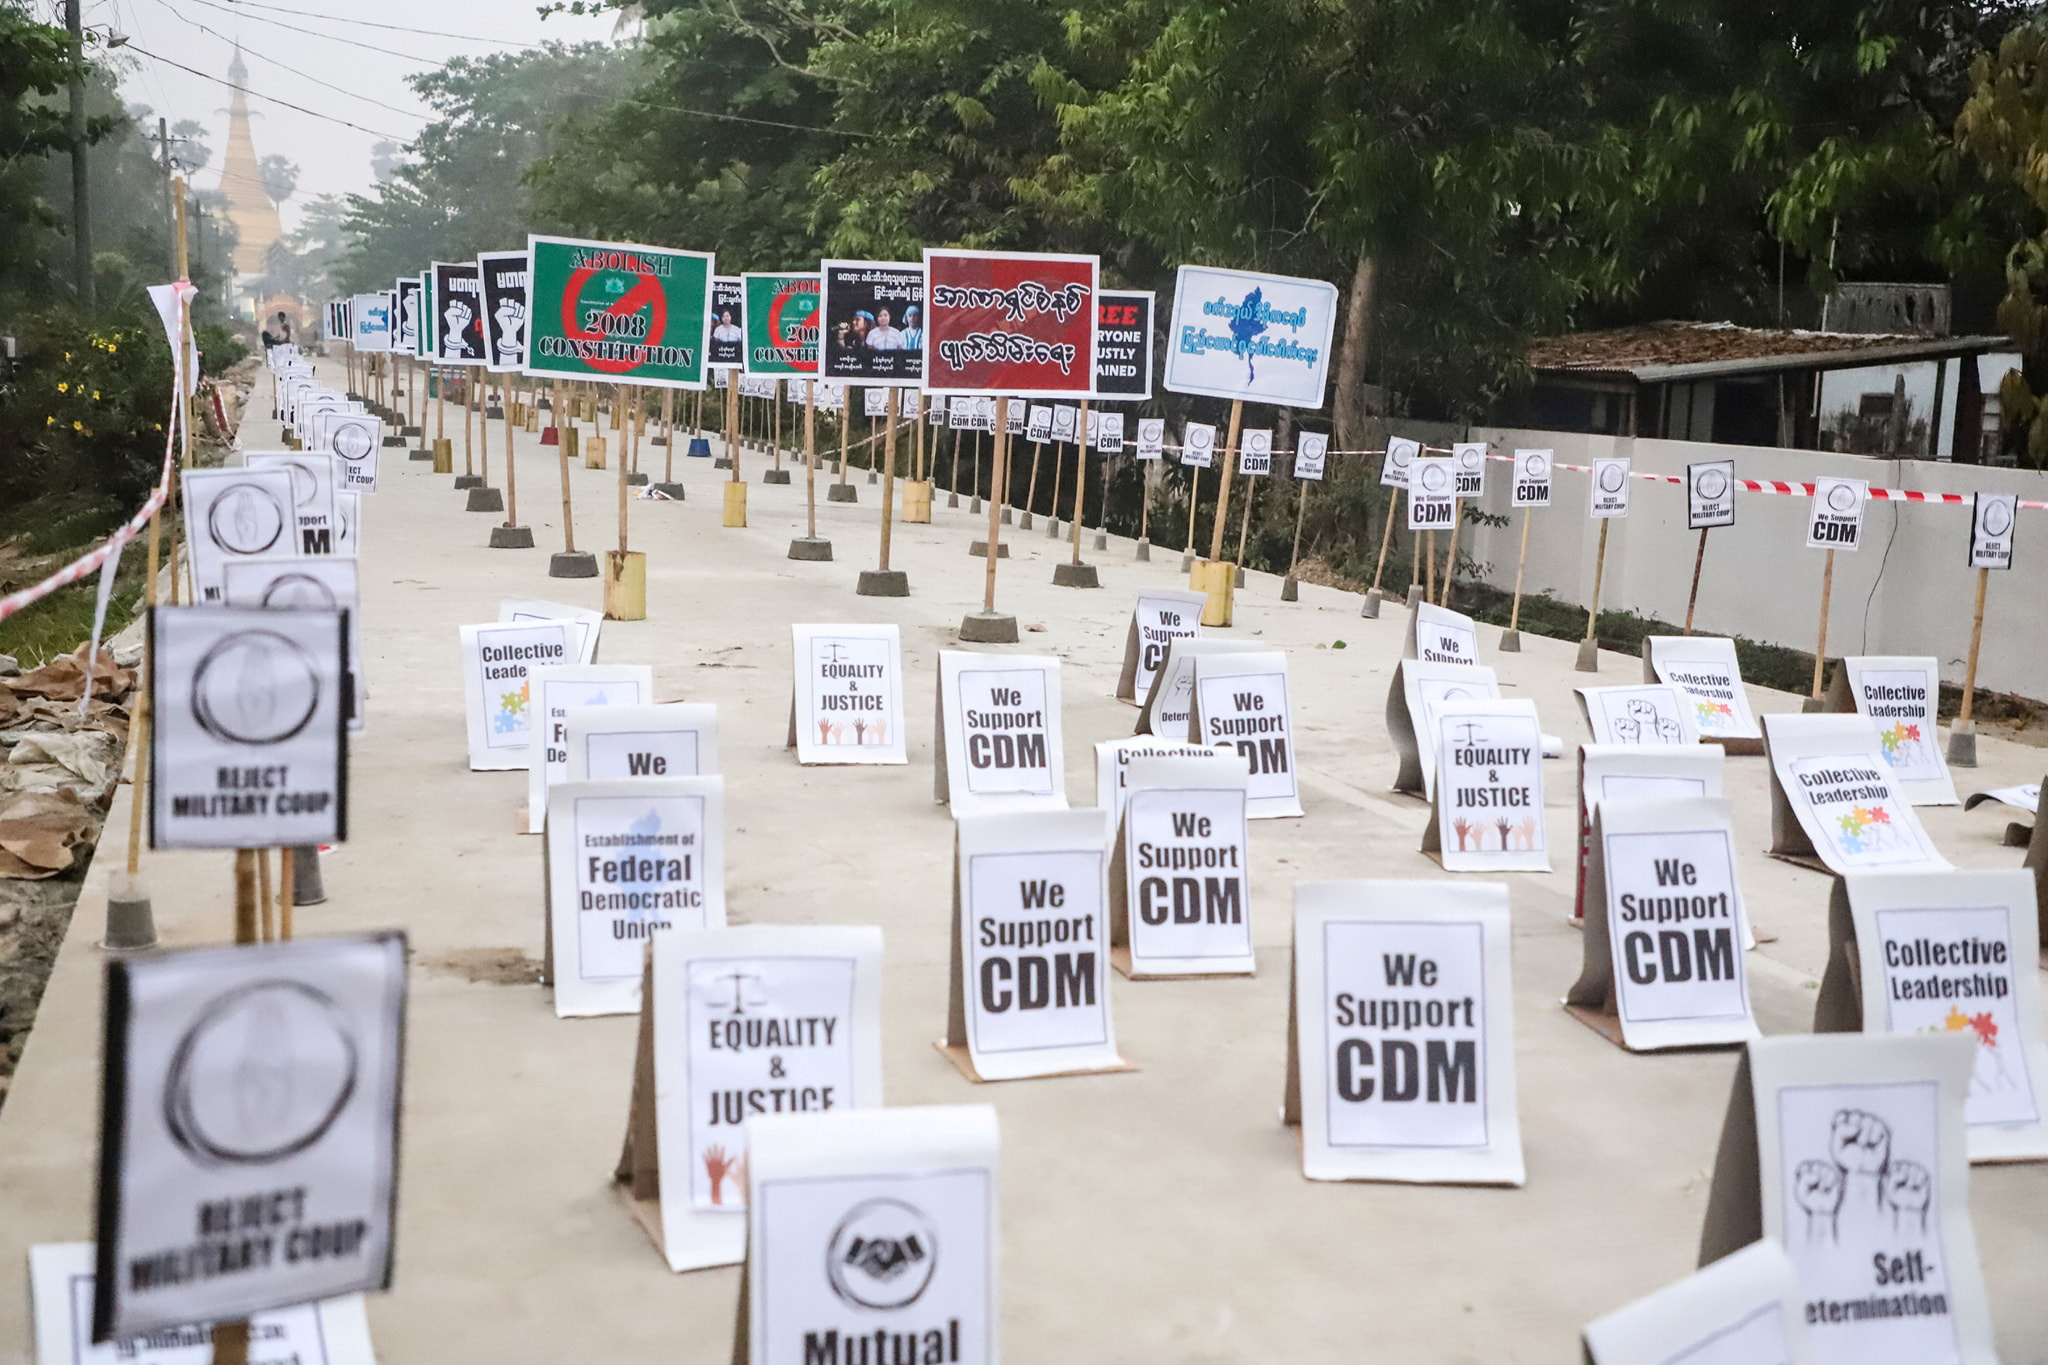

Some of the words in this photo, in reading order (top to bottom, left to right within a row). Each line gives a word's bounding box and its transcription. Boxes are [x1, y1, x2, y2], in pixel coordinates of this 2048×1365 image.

[570, 248, 672, 277] ABOLISH
[772, 279, 820, 295] ABOL
[933, 281, 1091, 323] အာဏာရှင်စနစ်
[585, 312, 646, 338] 2008
[1098, 305, 1139, 325] REE
[787, 325, 820, 343] 200
[1098, 330, 1142, 343] RYONE
[539, 336, 693, 367] CONSTITUTION
[754, 347, 820, 362] CONSTI
[1097, 347, 1136, 360] USTLY
[1097, 364, 1137, 377] AINED
[951, 417, 969, 426] CDM
[1030, 427, 1051, 439] CDM
[1100, 438, 1121, 448] CDM
[349, 466, 361, 474] ECT
[1244, 458, 1269, 471] CDM
[356, 475, 374, 485] COUP
[1455, 477, 1481, 492] CDM
[1426, 494, 1450, 503] Support
[1517, 485, 1549, 501] CDM
[299, 514, 327, 526] port
[1413, 504, 1452, 523] CDM
[1692, 510, 1716, 519] MILITARY
[1716, 509, 1730, 518] COUP
[1817, 513, 1829, 521] We
[1830, 513, 1857, 523] Support
[1813, 521, 1857, 543] CDM
[1160, 611, 1181, 627] We
[482, 642, 563, 663] Collective
[1440, 636, 1459, 653] We
[485, 663, 528, 680] Leade
[821, 663, 884, 679] EQUALITY
[1669, 671, 1731, 687] Collective
[849, 681, 858, 692] &
[991, 687, 1022, 707] We
[1685, 685, 1734, 701] adership
[1864, 684, 1926, 701] Collective
[821, 695, 884, 711] JUSTICE
[1233, 692, 1264, 712] We
[1868, 703, 1926, 719] Leadership
[967, 709, 1043, 730] Support
[1210, 714, 1284, 737] Support
[969, 733, 1047, 769] CDM
[1214, 738, 1288, 775] DM
[1455, 747, 1531, 768] EQUALITY
[628, 752, 667, 776] We
[216, 766, 288, 789] REJECT
[1488, 769, 1499, 783] &
[1798, 767, 1881, 788] Collective
[172, 794, 269, 818] MILITARY
[275, 792, 331, 815] COUP
[1456, 787, 1531, 808] JUSTICE
[1809, 785, 1889, 805] Leadership
[1172, 812, 1212, 838] We
[585, 833, 679, 848] Establishment
[682, 833, 695, 846] of
[1138, 842, 1239, 870] Support
[588, 854, 692, 884] Federal
[1654, 858, 1697, 887] We
[581, 887, 702, 911] Democratic
[1020, 879, 1064, 910] We
[1139, 876, 1241, 926] CDM
[1620, 891, 1729, 923] Support
[980, 914, 1094, 948] Support
[1624, 927, 1736, 986] CDM
[1885, 936, 2008, 968] Collective
[1383, 953, 1438, 988] We
[980, 952, 1097, 1013] CDM
[1891, 972, 2009, 1001] Leadership
[1336, 992, 1475, 1031] Support
[710, 1016, 836, 1052] EQUALITY
[769, 1054, 787, 1079] &
[1336, 1038, 1477, 1103] CDM
[1873, 1249, 1935, 1287] Self-
[1805, 1290, 1948, 1325] etermination
[804, 1318, 959, 1365] Mutual
